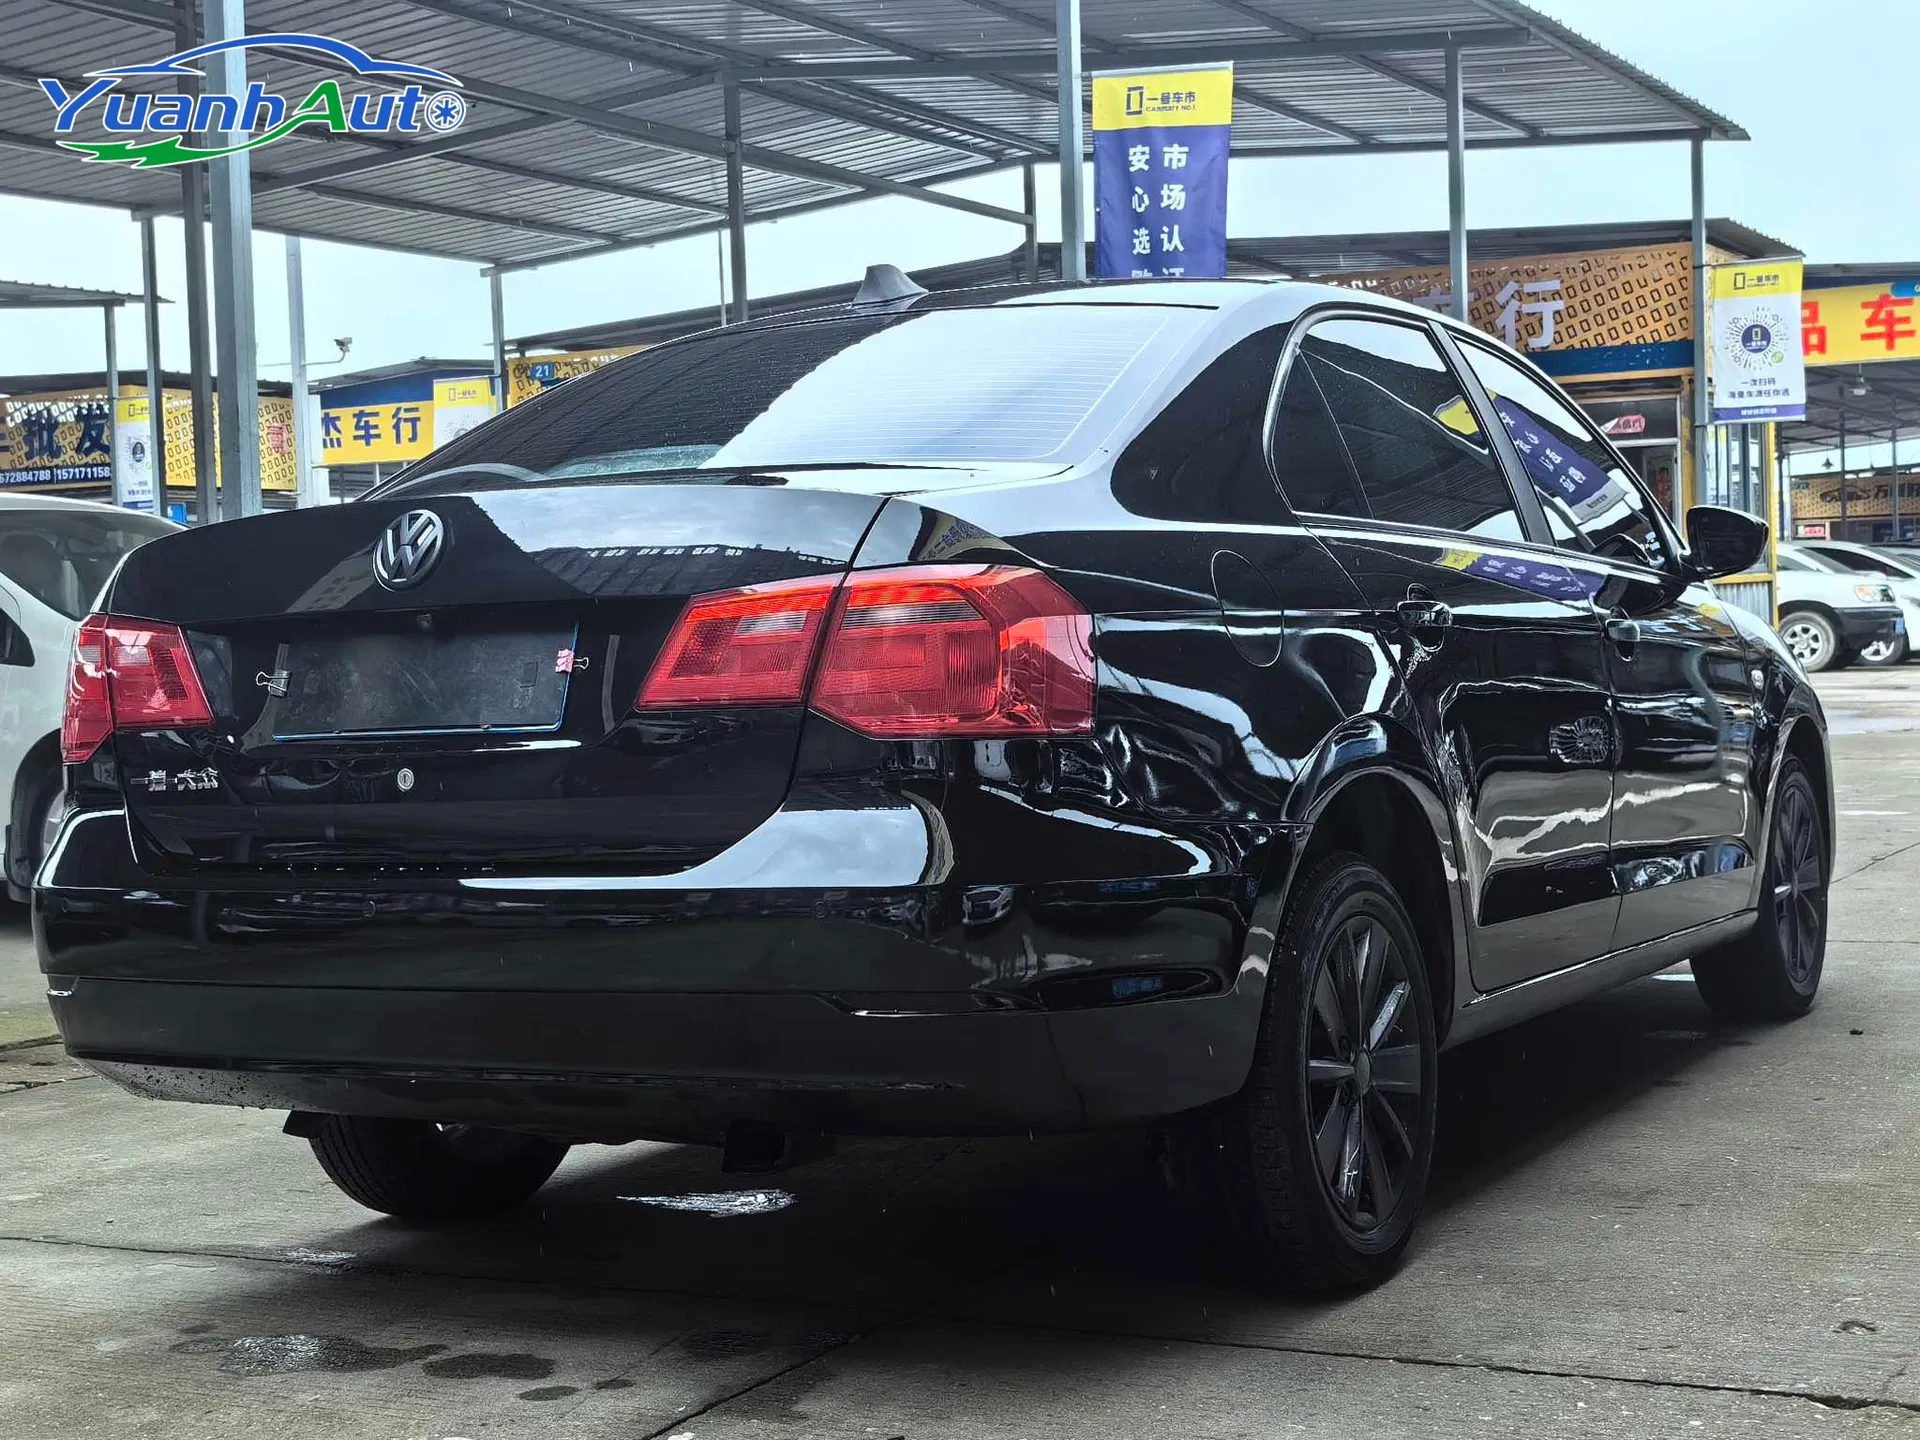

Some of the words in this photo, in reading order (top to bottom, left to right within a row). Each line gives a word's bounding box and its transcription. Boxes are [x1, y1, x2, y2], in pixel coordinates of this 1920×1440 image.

[1146, 91, 1197, 105] 一号车市
[535, 365, 550, 378] 21
[322, 406, 421, 450] 杰车行
[56, 466, 112, 480] 157171158
